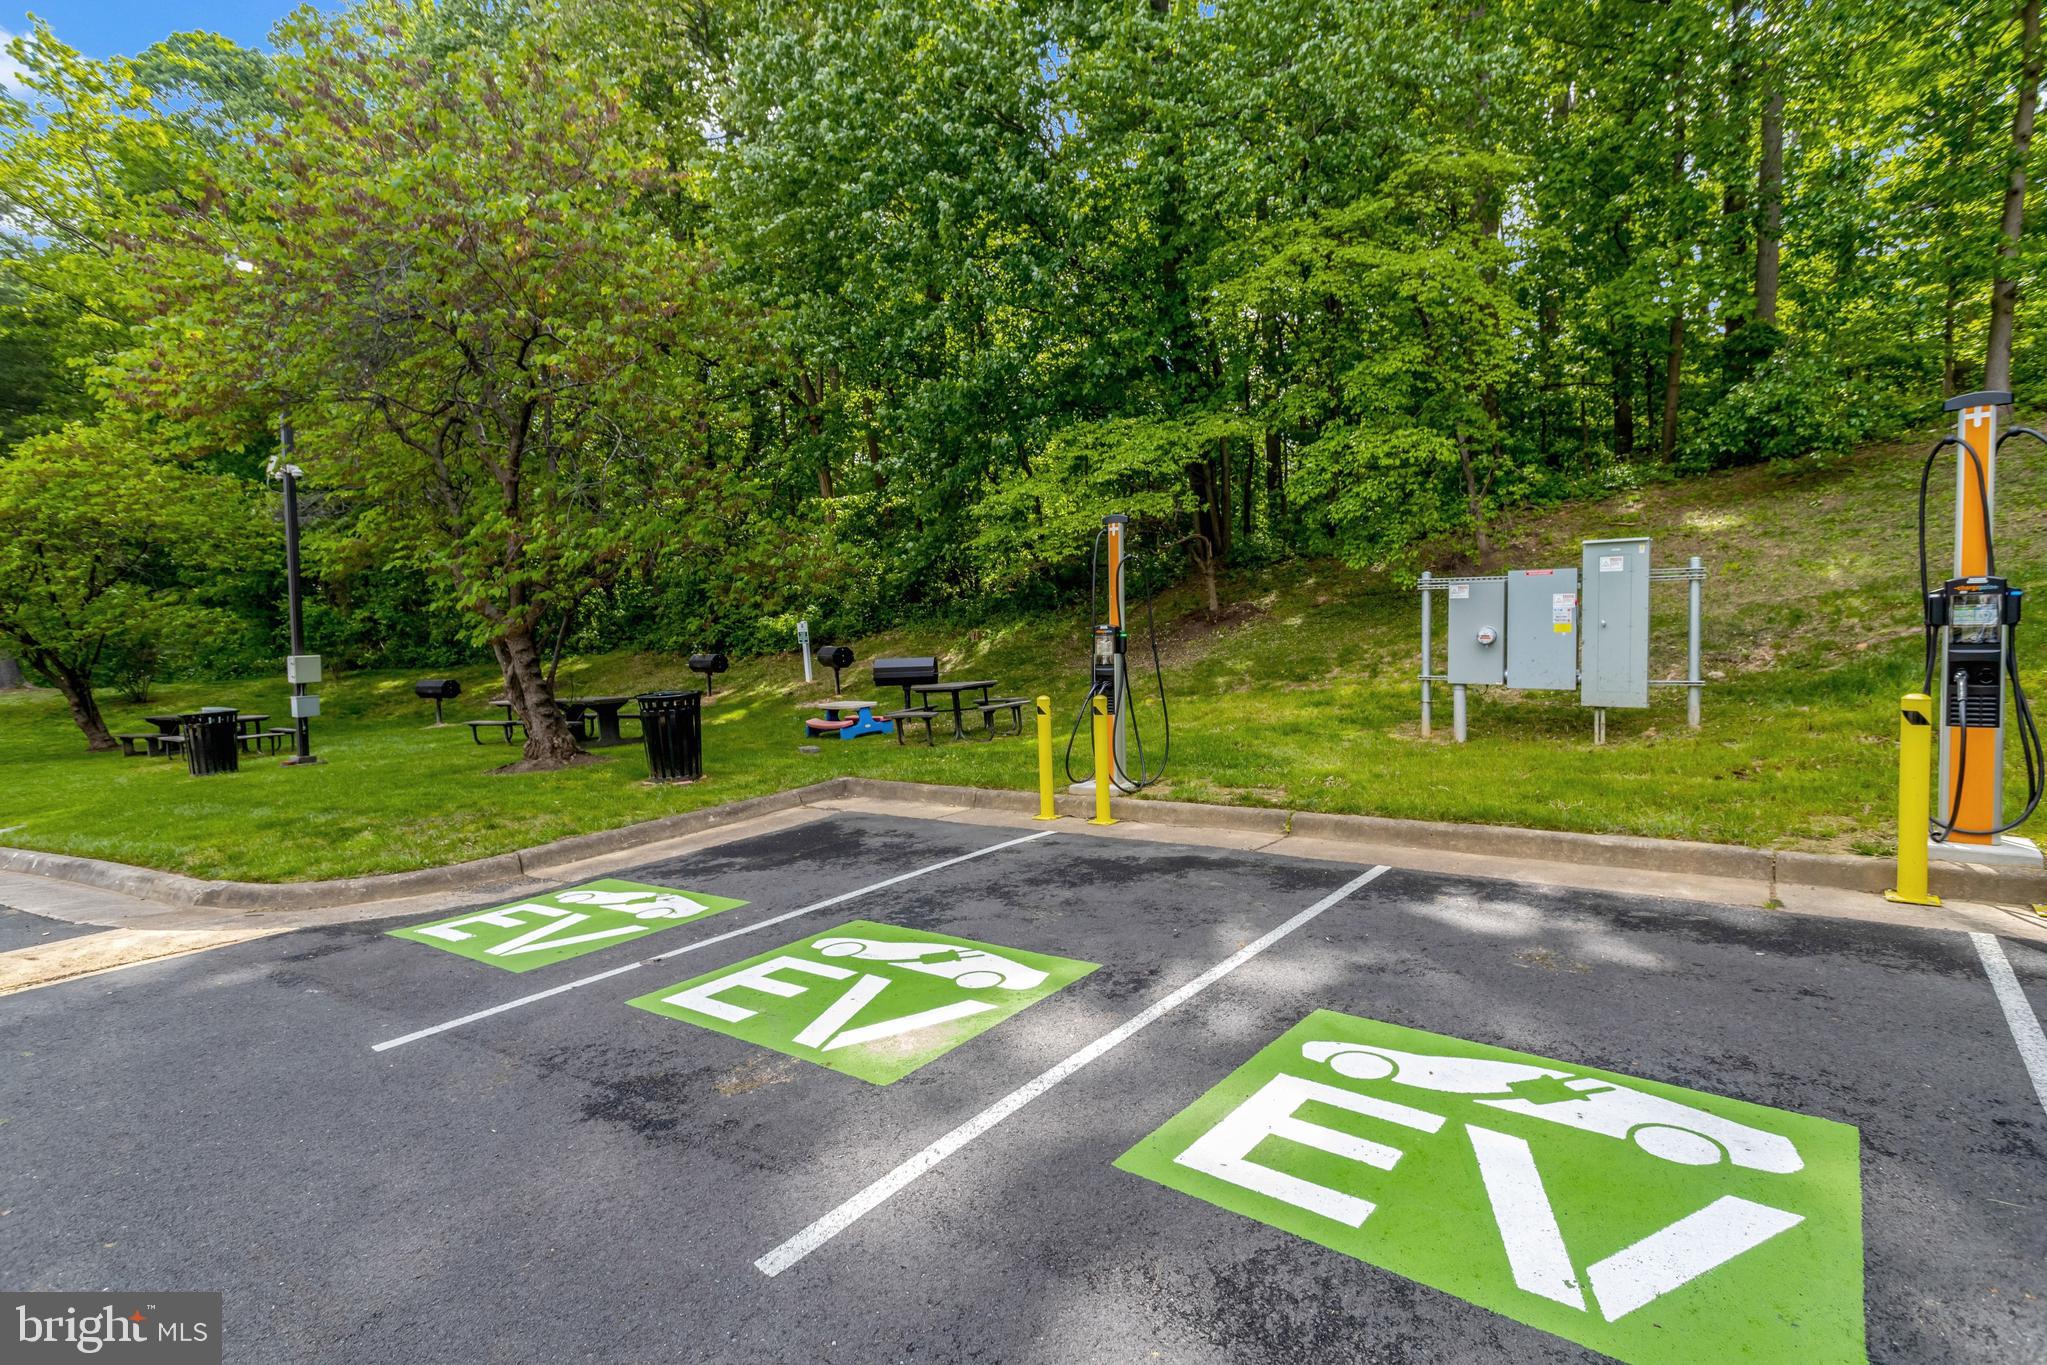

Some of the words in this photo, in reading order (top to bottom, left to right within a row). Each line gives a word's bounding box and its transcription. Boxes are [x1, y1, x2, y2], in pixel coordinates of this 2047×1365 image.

[414, 903, 650, 956] EV
[661, 956, 999, 1051] EV
[1173, 1073, 1806, 1323] EV
